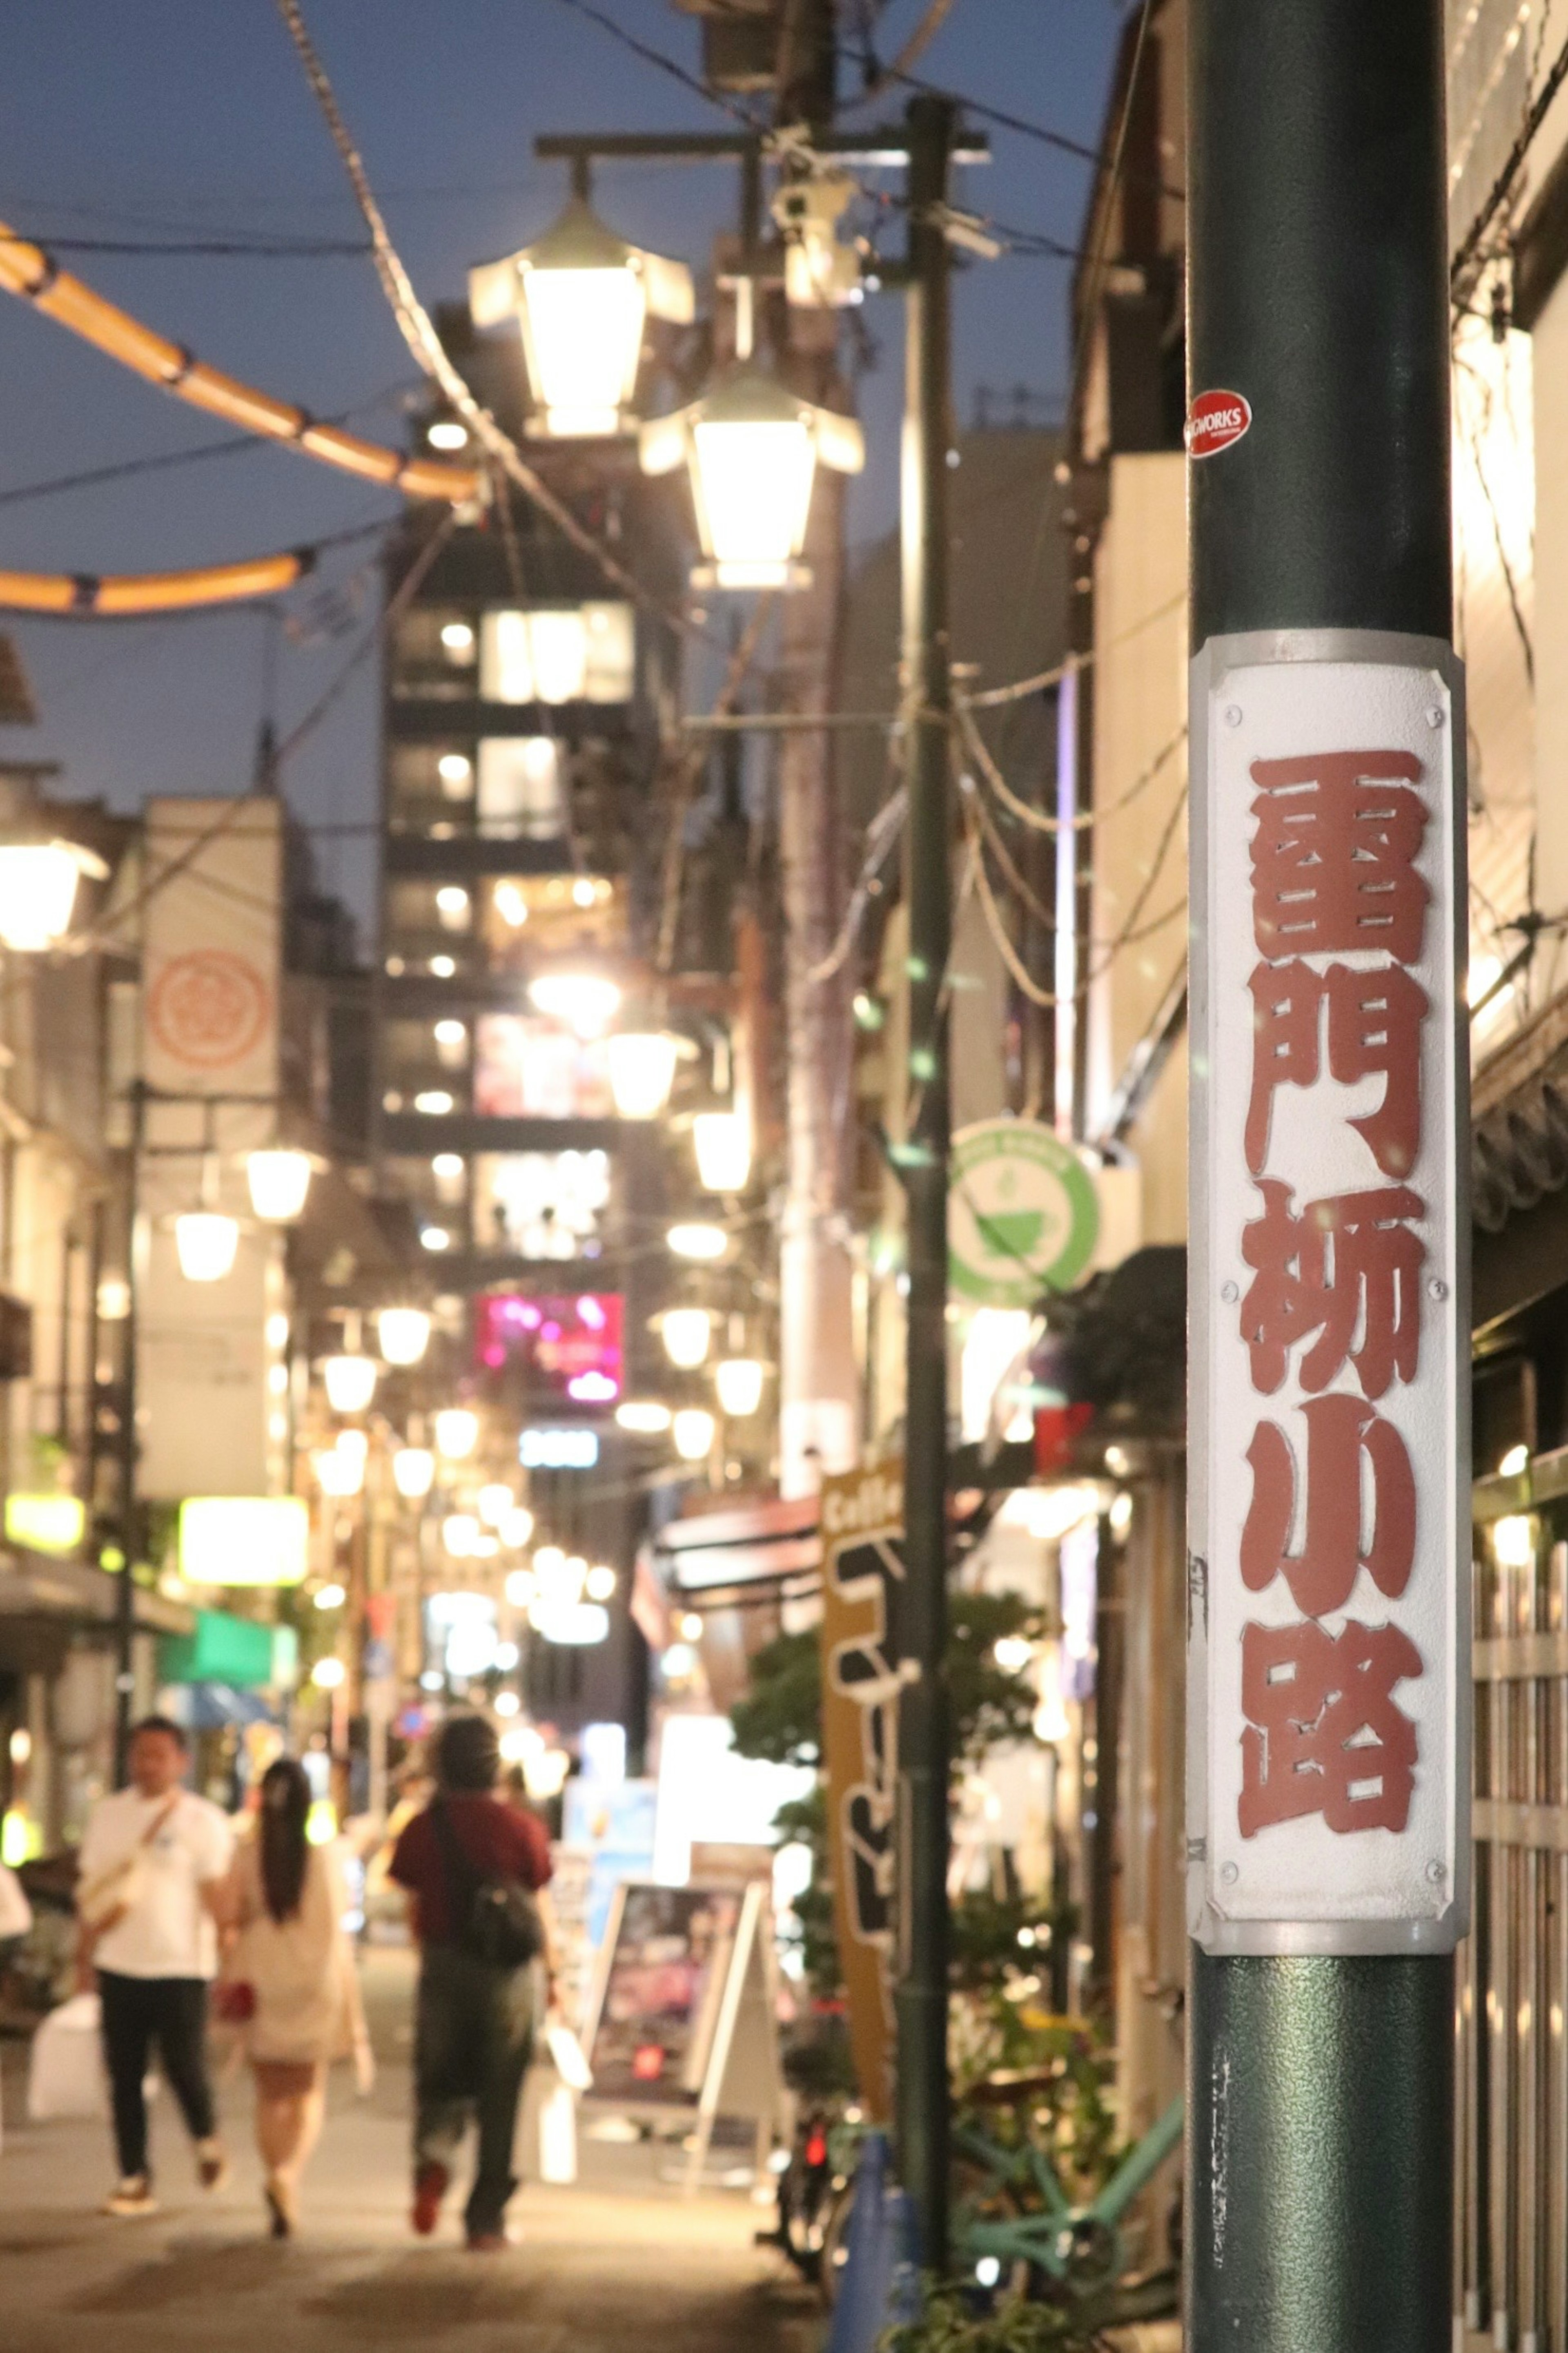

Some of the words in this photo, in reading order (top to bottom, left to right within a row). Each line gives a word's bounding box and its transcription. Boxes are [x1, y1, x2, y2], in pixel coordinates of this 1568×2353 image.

[1237, 749, 1430, 1840] 雷門柳小路
